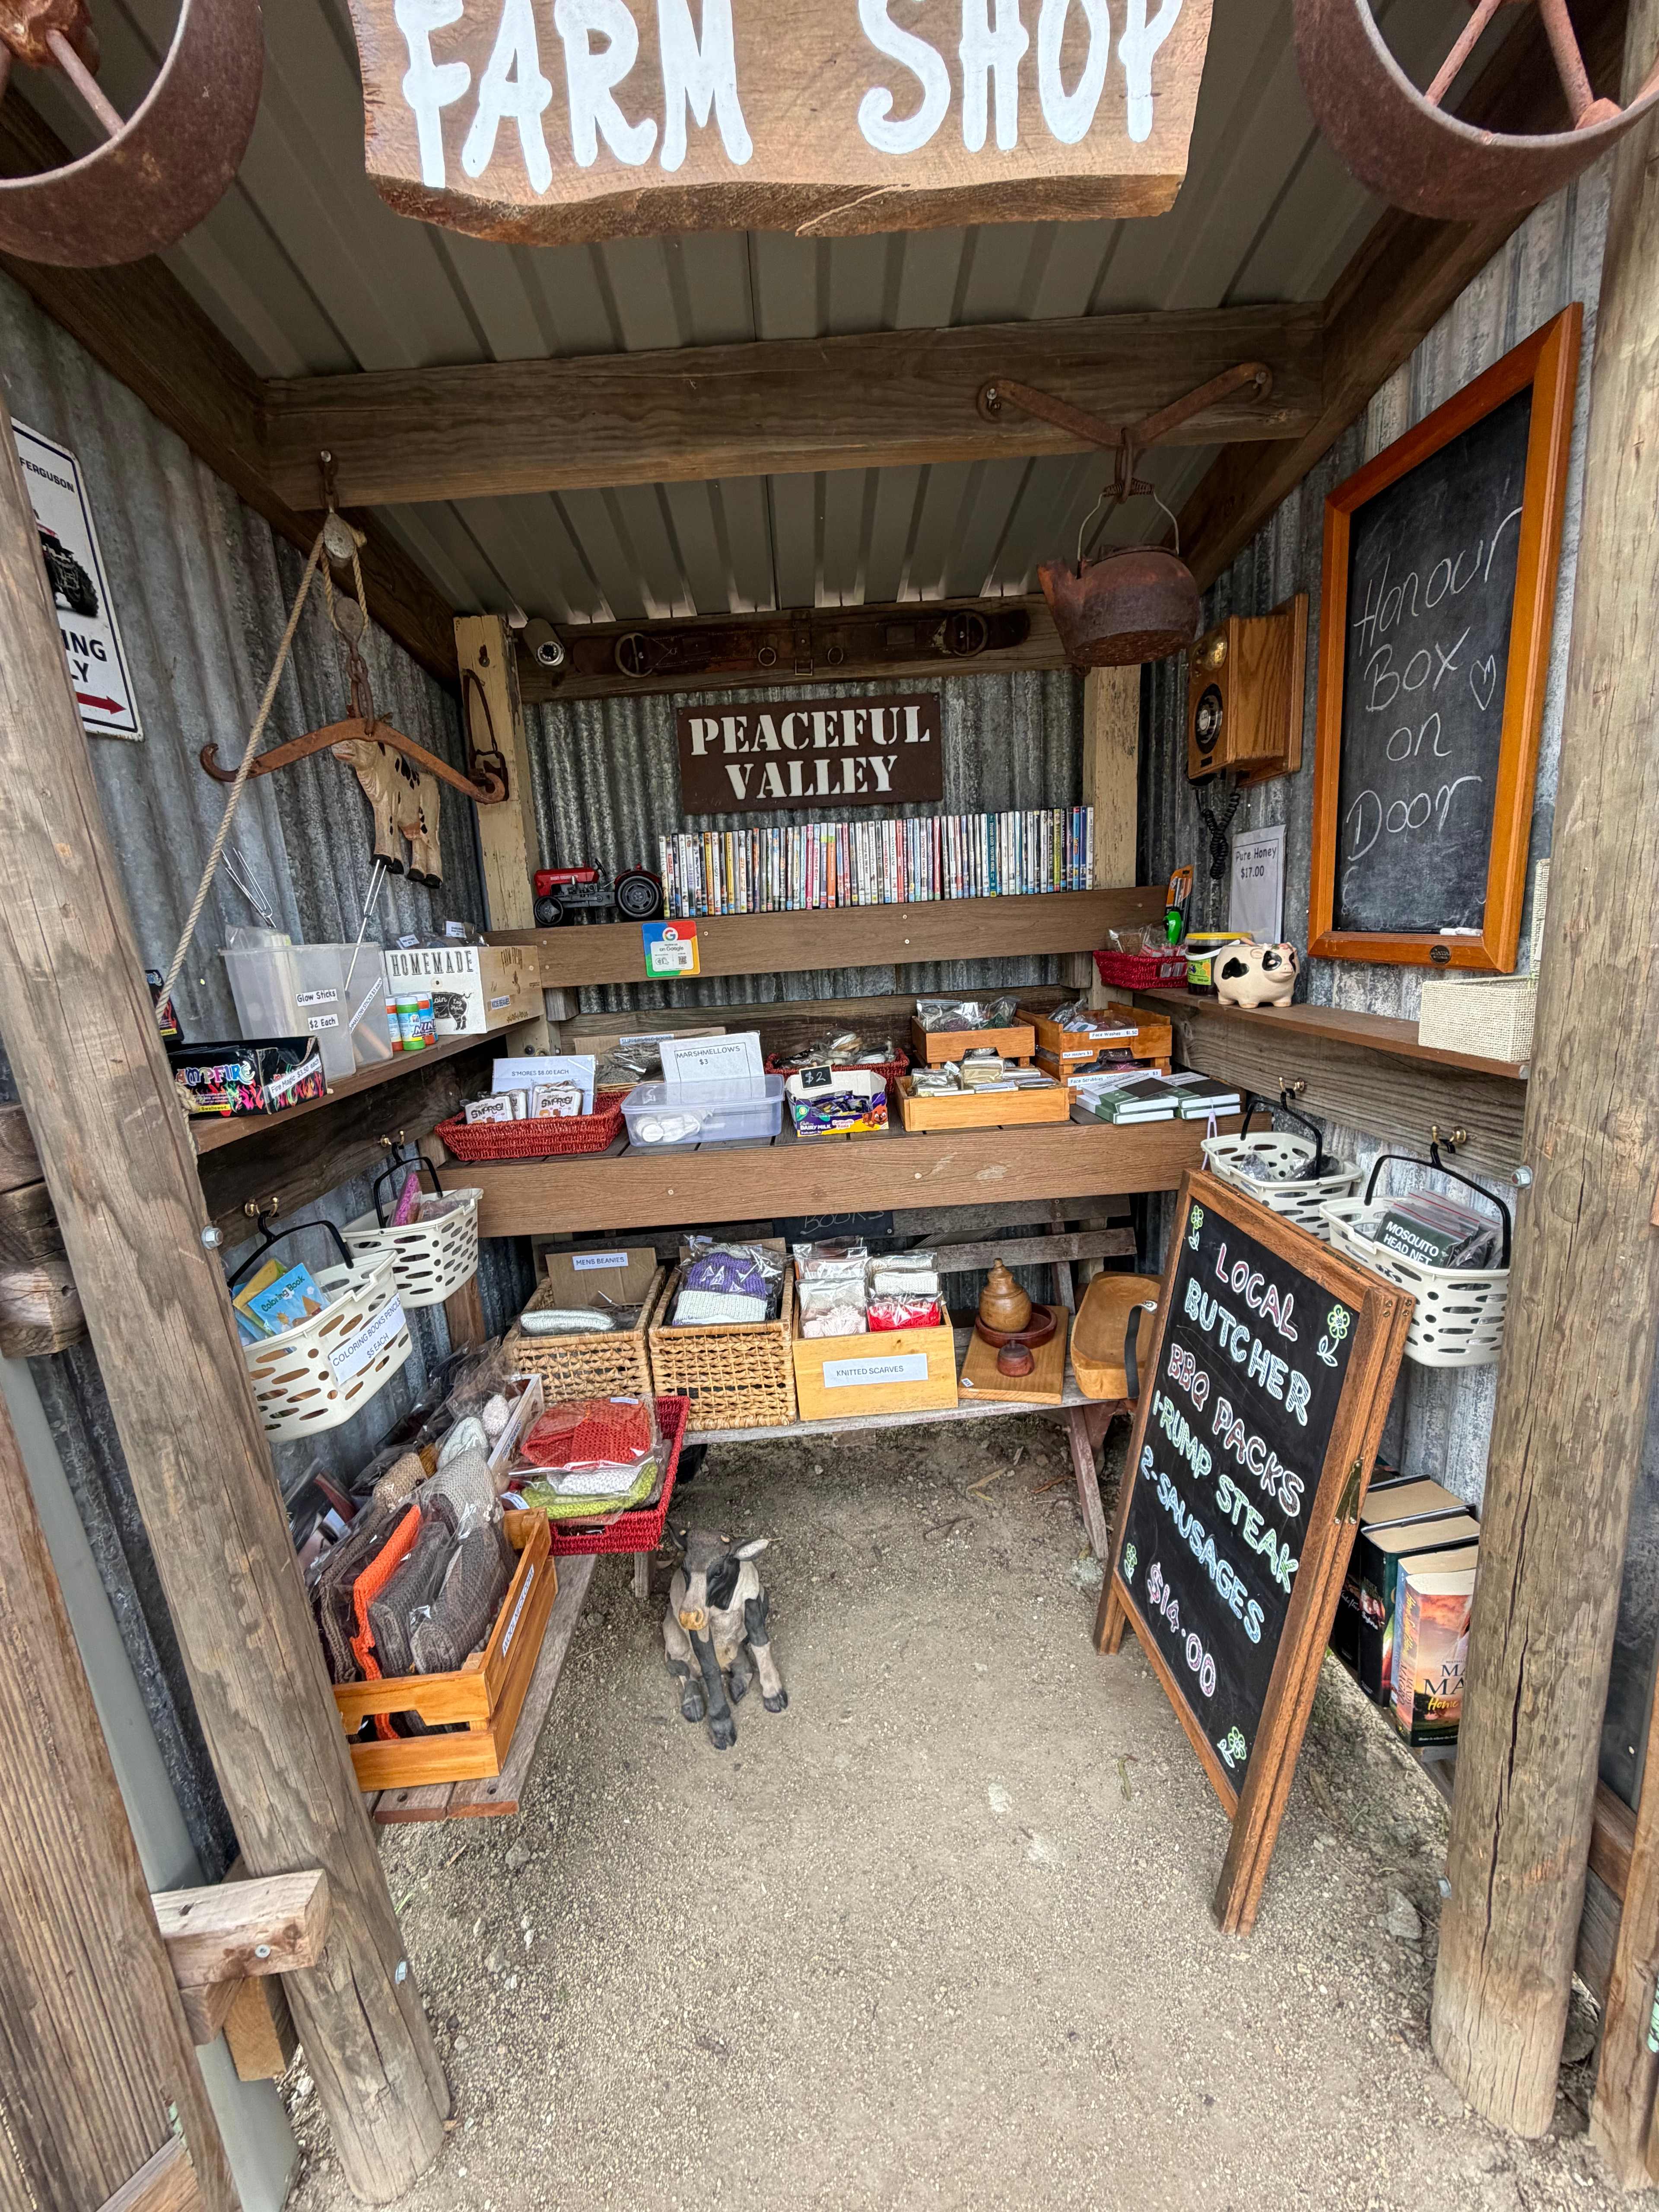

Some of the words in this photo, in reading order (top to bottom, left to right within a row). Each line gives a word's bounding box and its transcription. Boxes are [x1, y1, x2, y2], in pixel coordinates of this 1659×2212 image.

[393, 0, 754, 195] FARM
[858, 0, 1184, 154] SHOP
[20, 457, 75, 493] FERGUSON
[1354, 507, 1522, 656] Honour
[688, 706, 930, 756] PEACEFUL
[1387, 712, 1451, 761] on
[725, 755, 898, 800] VALLEY
[1346, 775, 1482, 861] Door
[1236, 850, 1252, 862] Pure
[1254, 846, 1277, 860] Honey
[1241, 865, 1264, 879] $17.00
[391, 950, 474, 976] HOMEMADE
[297, 994, 314, 1003] Glow
[317, 991, 336, 999] Sticks
[362, 993, 373, 1009] STICKS
[309, 1020, 318, 1029] $2
[321, 1017, 336, 1027] Each
[676, 1046, 740, 1058] MARSHMELLOWS
[175, 1061, 255, 1086] AMPFIRE
[271, 1085, 282, 1093] Fire
[282, 1076, 296, 1090] Magic
[296, 1067, 309, 1079] $3.50
[310, 1058, 320, 1071] each
[805, 1071, 826, 1084] $2
[1383, 1233, 1409, 1254] HEAD
[1410, 1249, 1433, 1265] NET
[1386, 1221, 1439, 1257] MOSQUITO
[575, 1258, 596, 1266] MENS
[597, 1255, 625, 1264] BEANIES
[261, 1288, 290, 1313] Coloring
[288, 1275, 306, 1292] Book
[1215, 1243, 1298, 1342] LOCAL
[332, 1330, 369, 1367] COLORING
[367, 1314, 386, 1338] BOOKS
[384, 1297, 402, 1321] PENCILS
[366, 1348, 375, 1359] $5
[374, 1332, 390, 1353] EACH
[1185, 1278, 1311, 1426] BUTCHER
[836, 1367, 868, 1377] KNITTED
[869, 1365, 904, 1375] SCARVES
[1167, 1343, 1210, 1412] BBQ
[1212, 1396, 1305, 1517] PACKS
[1216, 1474, 1299, 1594] STEAK
[1146, 1562, 1216, 1697] $14.00
[1427, 1697, 1459, 1711] Home
